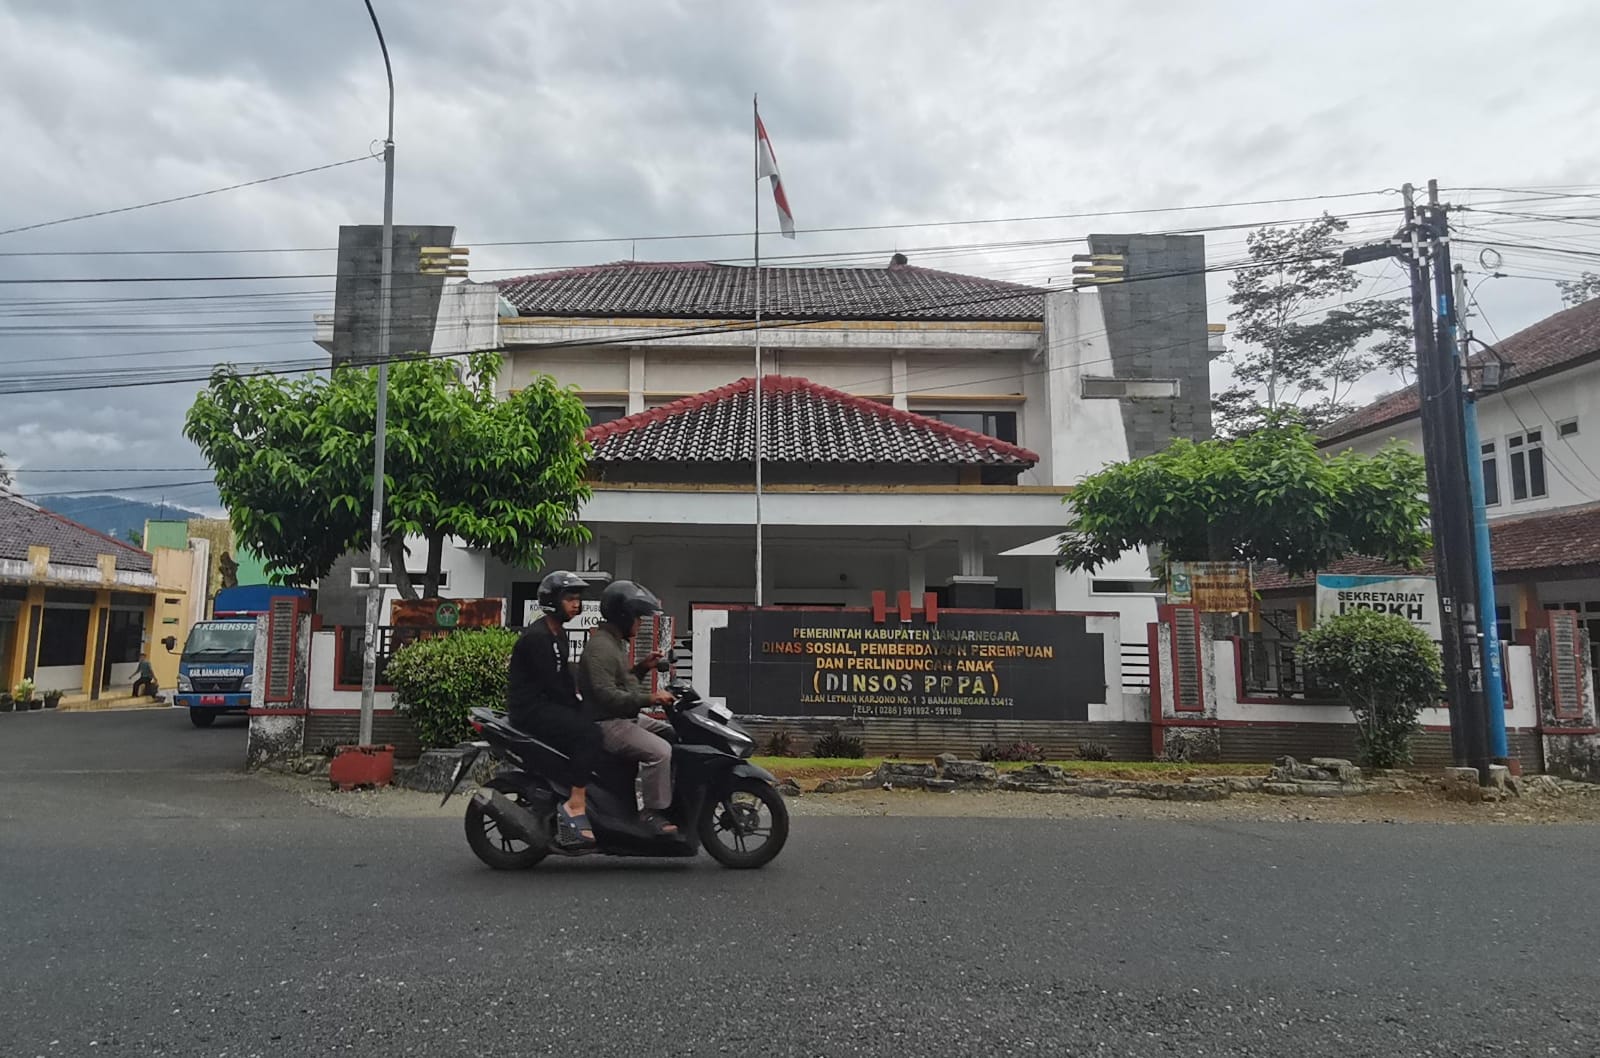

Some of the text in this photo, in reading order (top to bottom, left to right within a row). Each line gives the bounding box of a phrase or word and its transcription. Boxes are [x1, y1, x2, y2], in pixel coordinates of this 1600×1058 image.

[1337, 591, 1424, 602] SEKRETARIAT
[793, 628, 1020, 641] PEMERINTAH KABUPATEN BANJARNEGARA
[762, 642, 802, 653] DINAS
[806, 643, 857, 656] SOSIAL,
[970, 645, 1053, 658] PEREMPUAN
[816, 658, 995, 672] DAN PERLINDUNGAN ANAK
[202, 668, 244, 677] BANJARNEGARA
[800, 694, 825, 702] JALAN
[927, 696, 990, 705] BANJARNEGARA
[991, 697, 1014, 706] 53412
